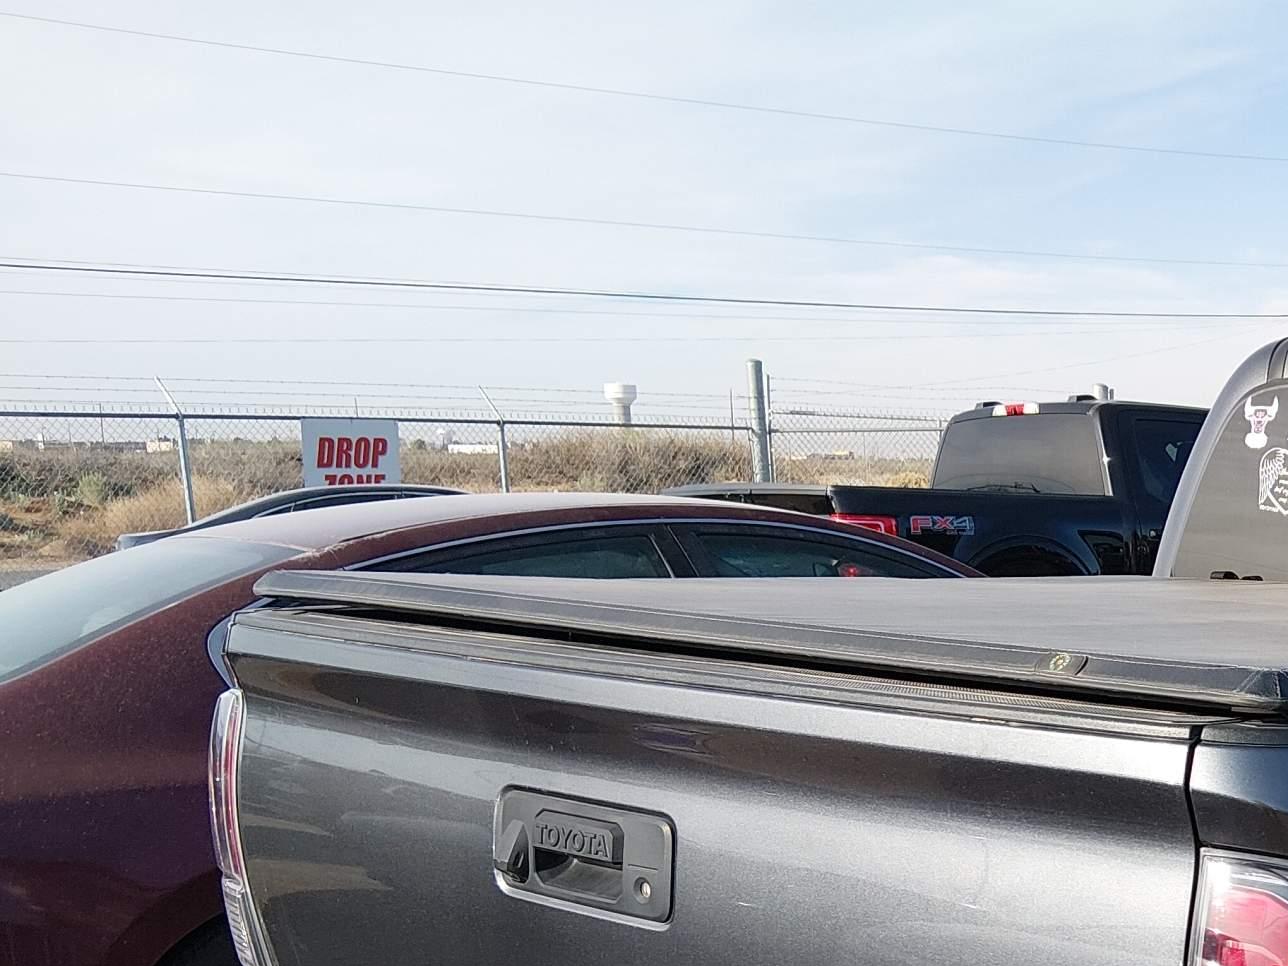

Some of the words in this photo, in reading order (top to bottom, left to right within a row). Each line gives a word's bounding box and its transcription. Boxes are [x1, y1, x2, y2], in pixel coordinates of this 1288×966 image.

[316, 436, 389, 470] DROP
[909, 515, 975, 535] FX4
[535, 823, 609, 859] TOYOTA
